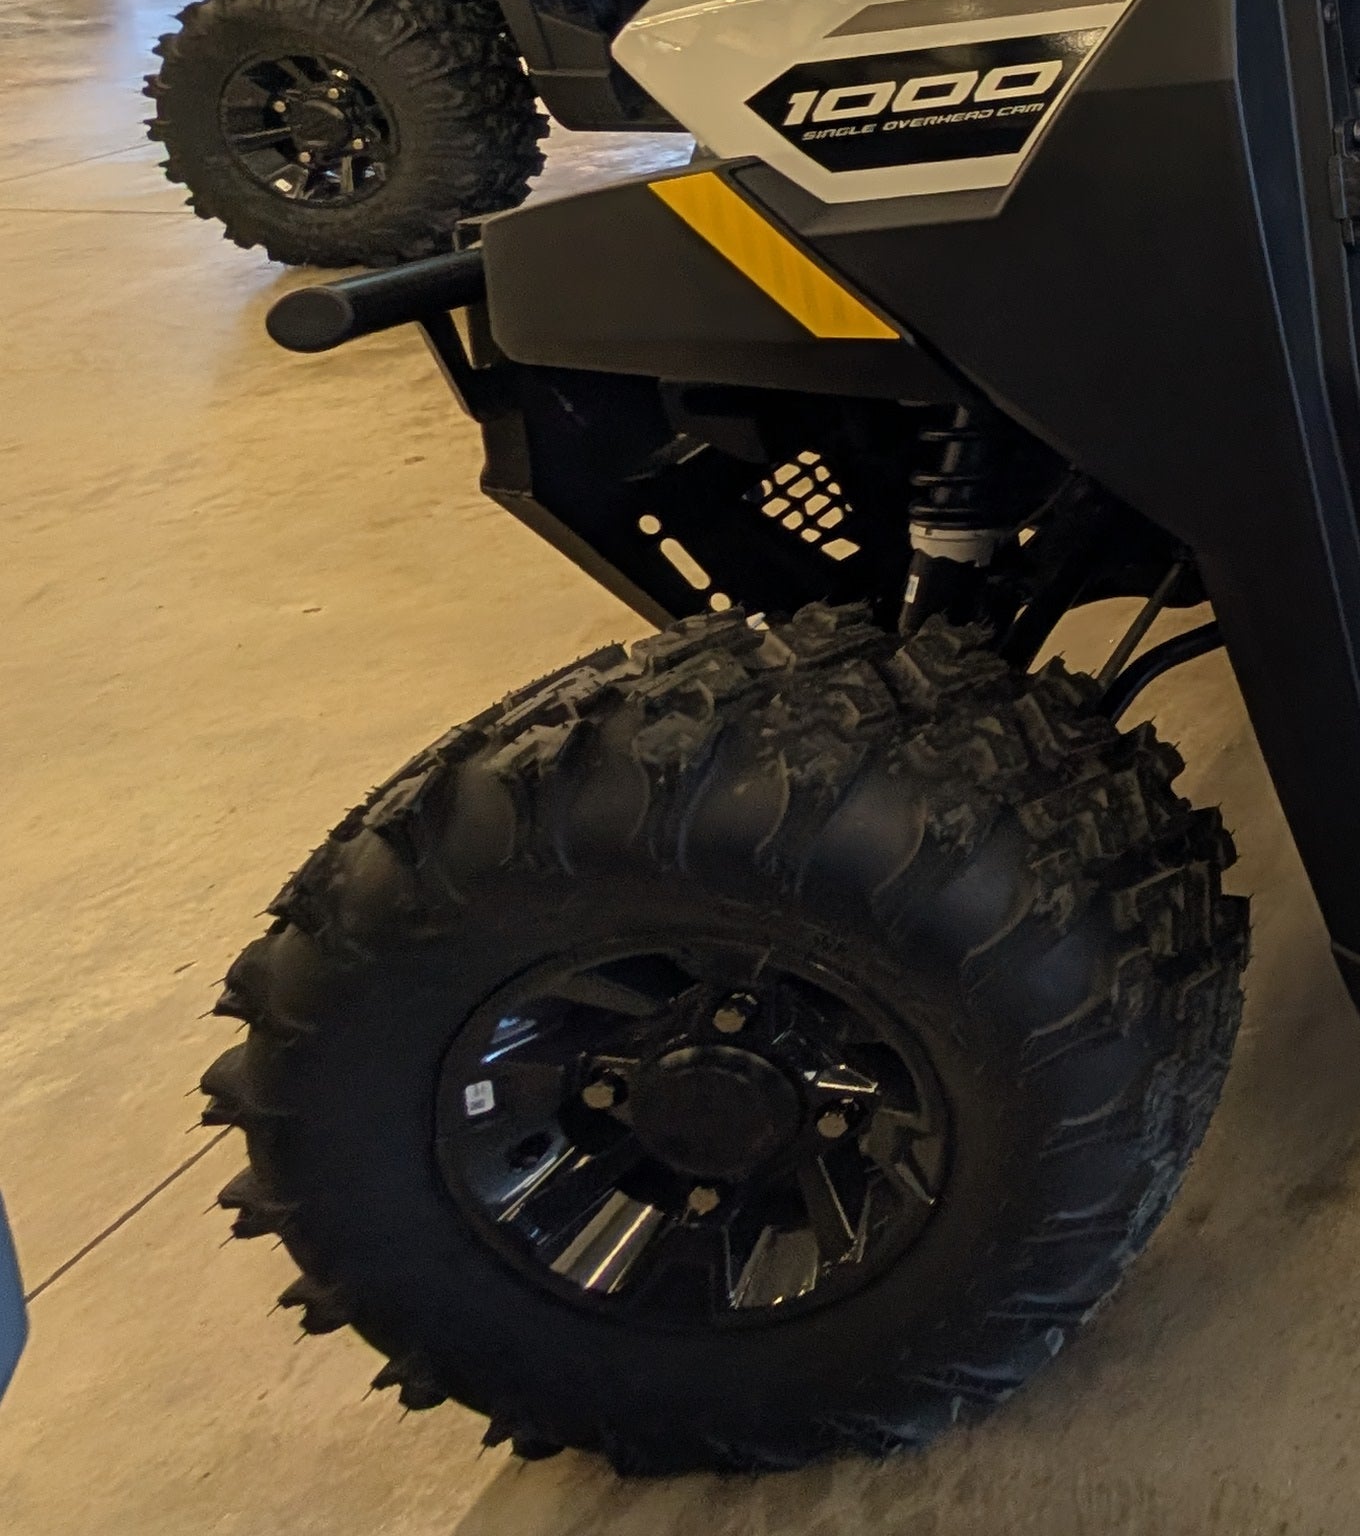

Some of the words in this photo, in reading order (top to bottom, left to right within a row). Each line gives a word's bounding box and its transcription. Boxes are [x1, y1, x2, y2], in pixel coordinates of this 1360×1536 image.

[783, 60, 1063, 127] 1000
[802, 123, 877, 141] SINGLE
[882, 108, 994, 132] OVERHEAD
[995, 103, 1045, 117] CAM
